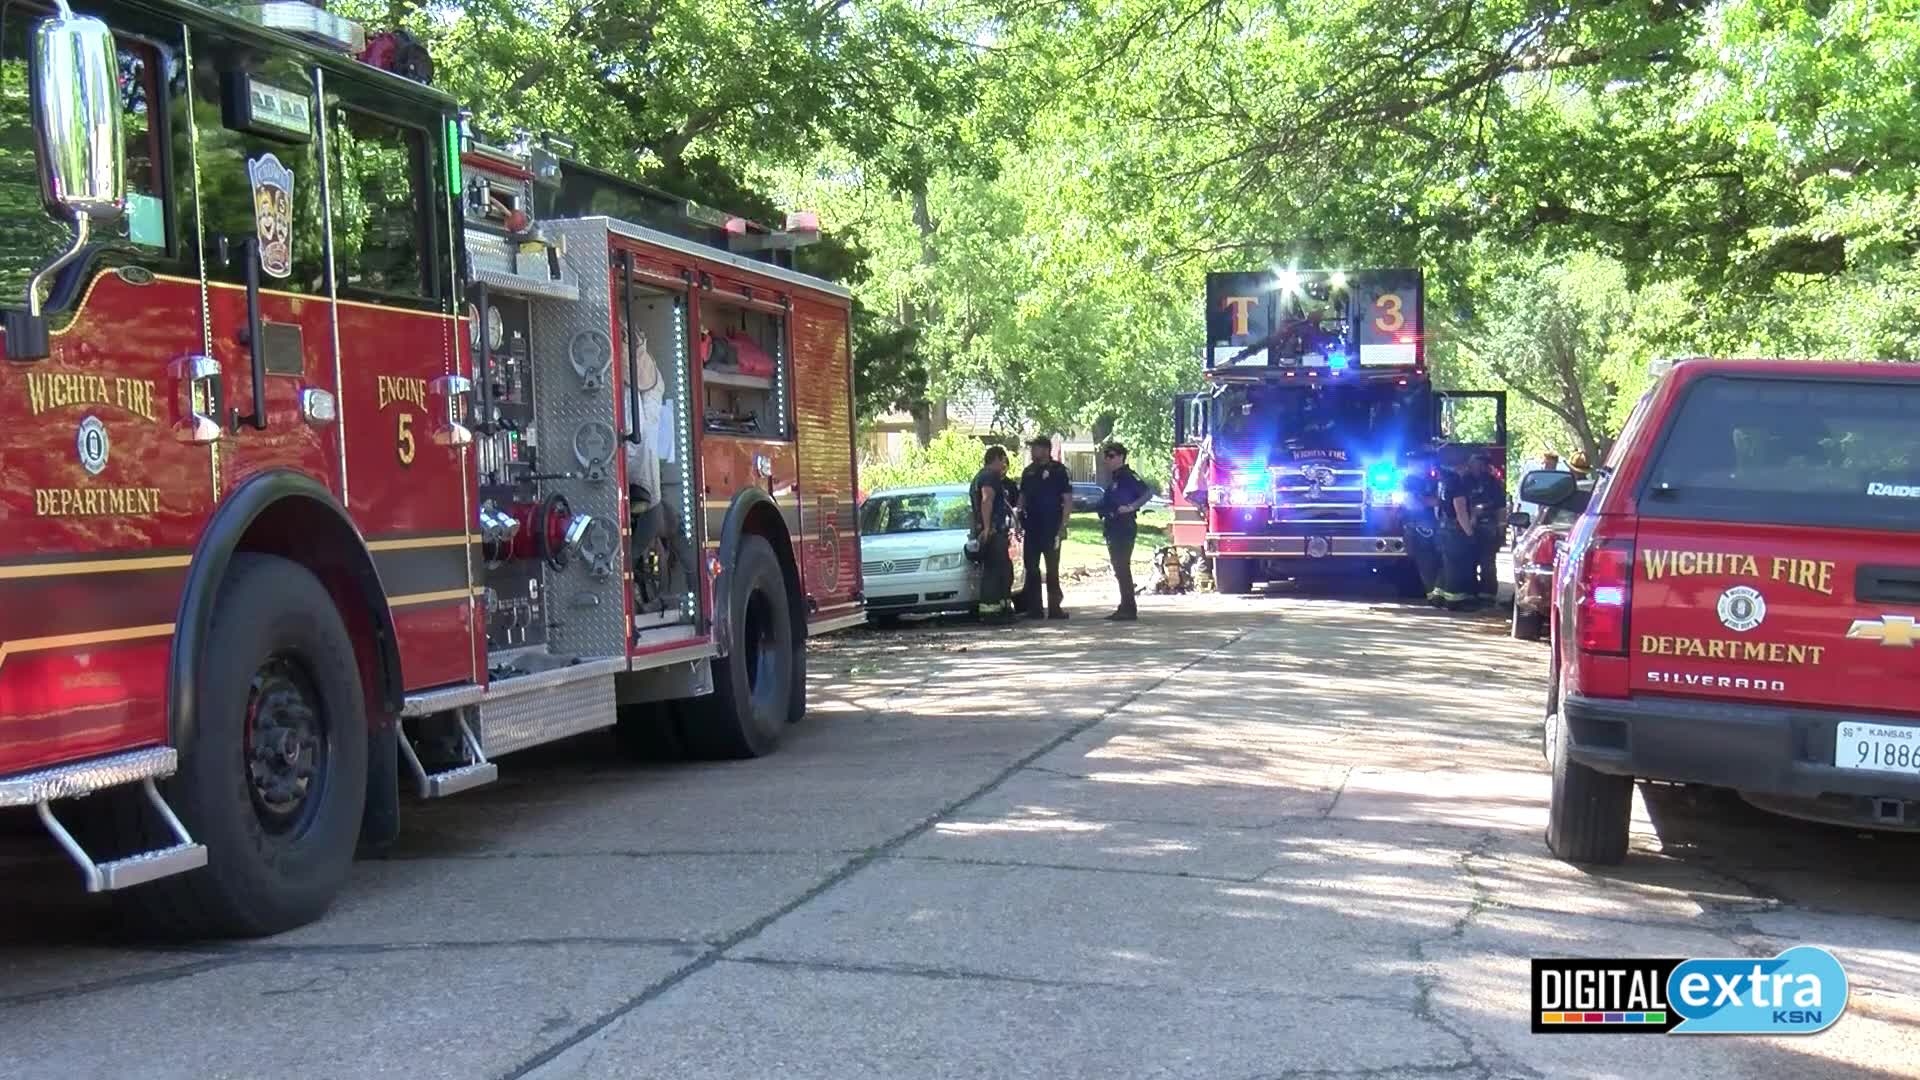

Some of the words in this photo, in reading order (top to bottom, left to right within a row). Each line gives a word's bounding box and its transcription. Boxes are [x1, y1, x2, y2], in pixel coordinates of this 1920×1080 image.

[1225, 296, 1258, 336] T
[1375, 294, 1404, 332] 3
[27, 372, 110, 416] WICHITA
[115, 377, 157, 421] FIRE
[377, 375, 429, 414] ENGINE
[398, 413, 416, 465] 5
[35, 488, 160, 516] DEPARTMENT
[1642, 549, 1760, 581] WICHITA
[1771, 557, 1836, 596] FIRE
[1641, 635, 1825, 665] DEPARTMENT
[1647, 672, 1785, 692] SILVERADO
[1869, 728, 1913, 740] KANSAS
